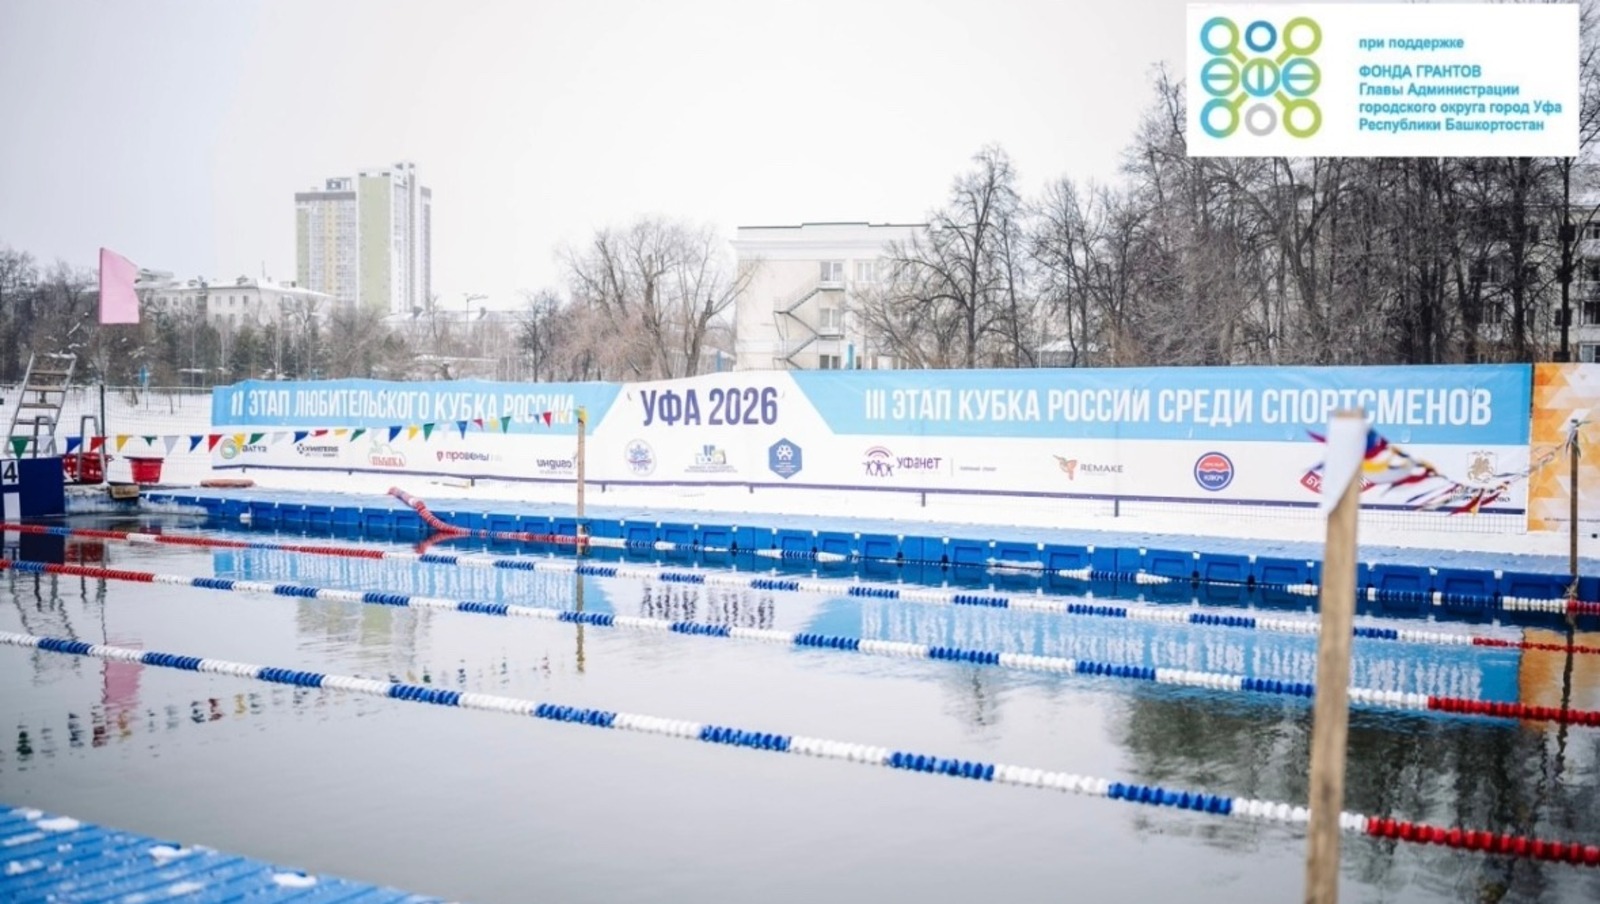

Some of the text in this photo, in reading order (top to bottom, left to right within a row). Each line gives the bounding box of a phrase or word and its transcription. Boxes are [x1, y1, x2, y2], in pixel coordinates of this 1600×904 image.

[249, 390, 289, 416] ЭТАП
[294, 390, 429, 420] ЛЮБИТЕЛЬСКОГО
[435, 392, 497, 421] КУБКА
[503, 393, 574, 424] РОССИИ
[641, 386, 778, 426] УФА 2026
[866, 388, 1492, 427] III ЭТАП КУБКА РОССИИ СРЕДИ СПОРТСМЕНОВ
[3, 462, 18, 483] 4
[1080, 463, 1124, 474] REMAKE
